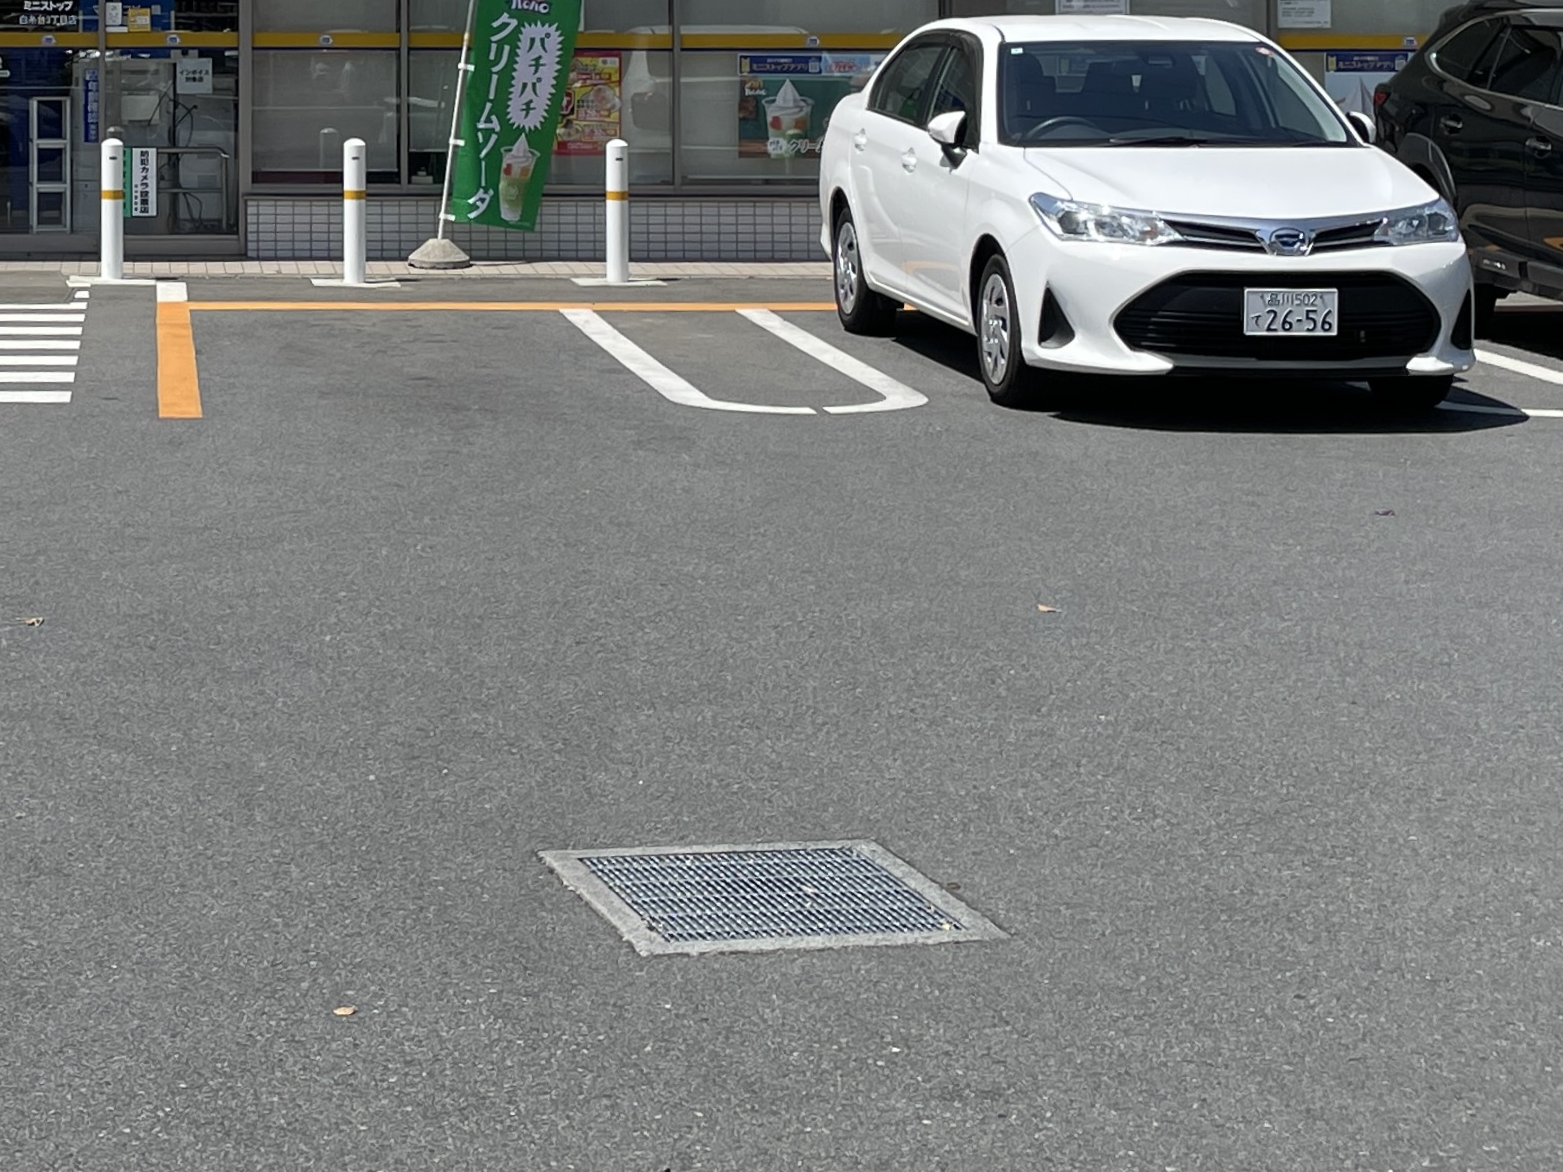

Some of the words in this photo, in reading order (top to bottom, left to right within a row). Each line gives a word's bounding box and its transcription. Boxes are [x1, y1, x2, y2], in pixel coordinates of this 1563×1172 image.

[23, 0, 74, 12] ミニストップ
[518, 31, 552, 120] パチパチ
[467, 12, 519, 219] クリームソーダ
[1267, 292, 1295, 306] 品川
[1295, 293, 1318, 307] 502
[1265, 308, 1333, 332] 26-56
